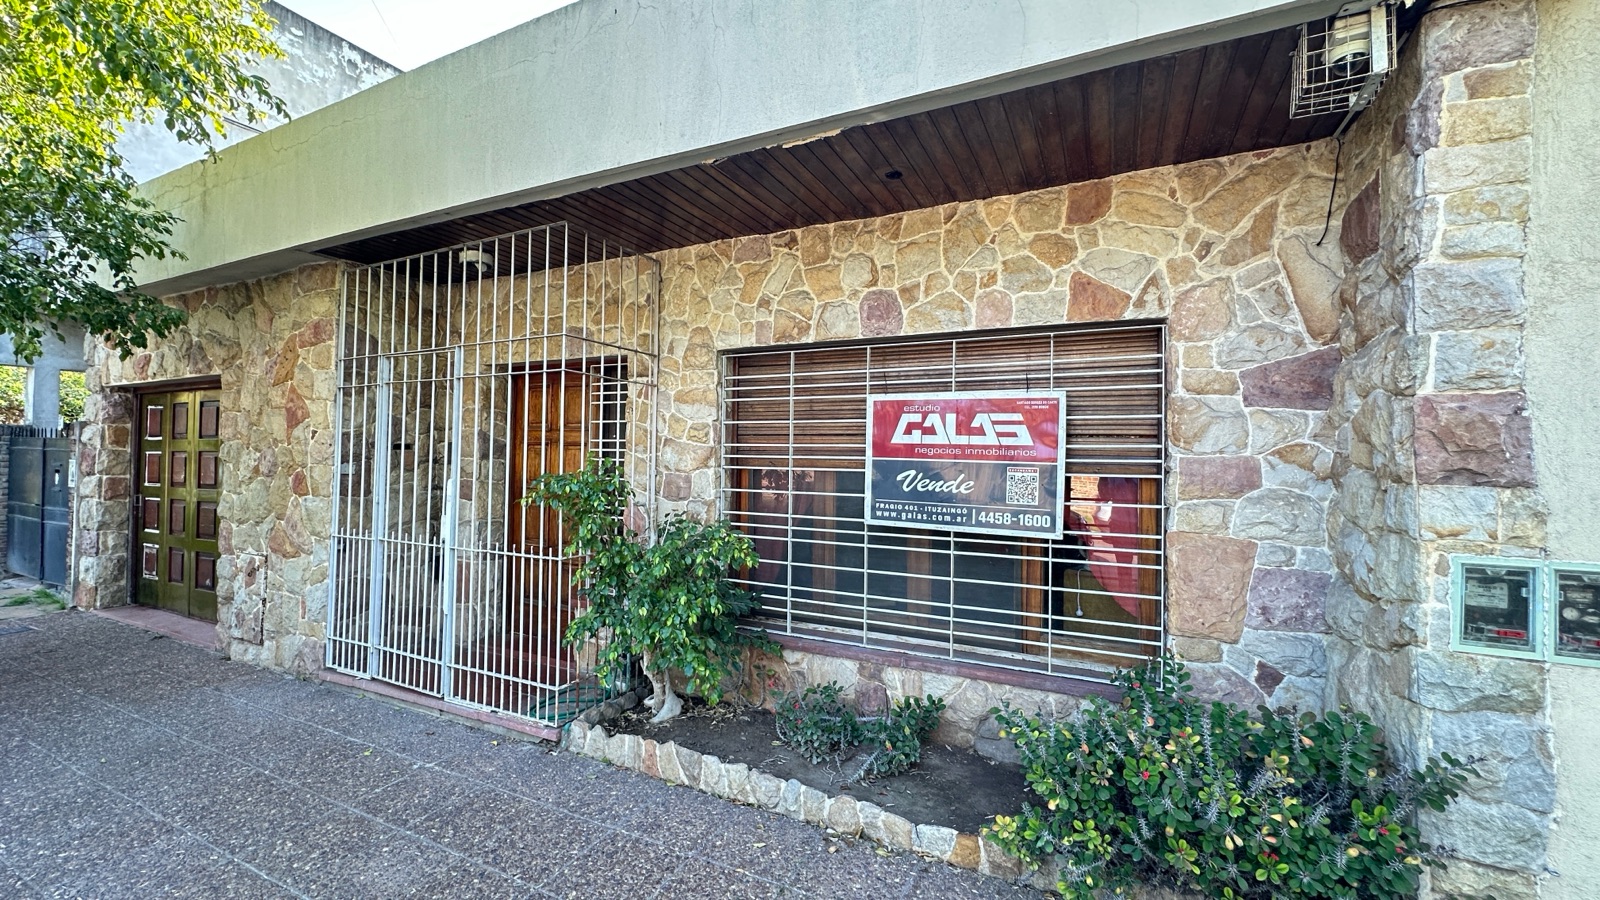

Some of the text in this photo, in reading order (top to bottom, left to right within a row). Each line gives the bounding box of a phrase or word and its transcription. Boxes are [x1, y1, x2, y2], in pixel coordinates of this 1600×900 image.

[903, 404, 941, 412] estudio
[890, 412, 1035, 446] GALAS
[914, 447, 1037, 457] negocios inmobiliarios
[896, 469, 975, 494] Vende
[924, 505, 968, 514] ITUZAINGÓ
[875, 510, 968, 523] www.galas.com.ar
[978, 511, 1051, 528] 4458-1600
